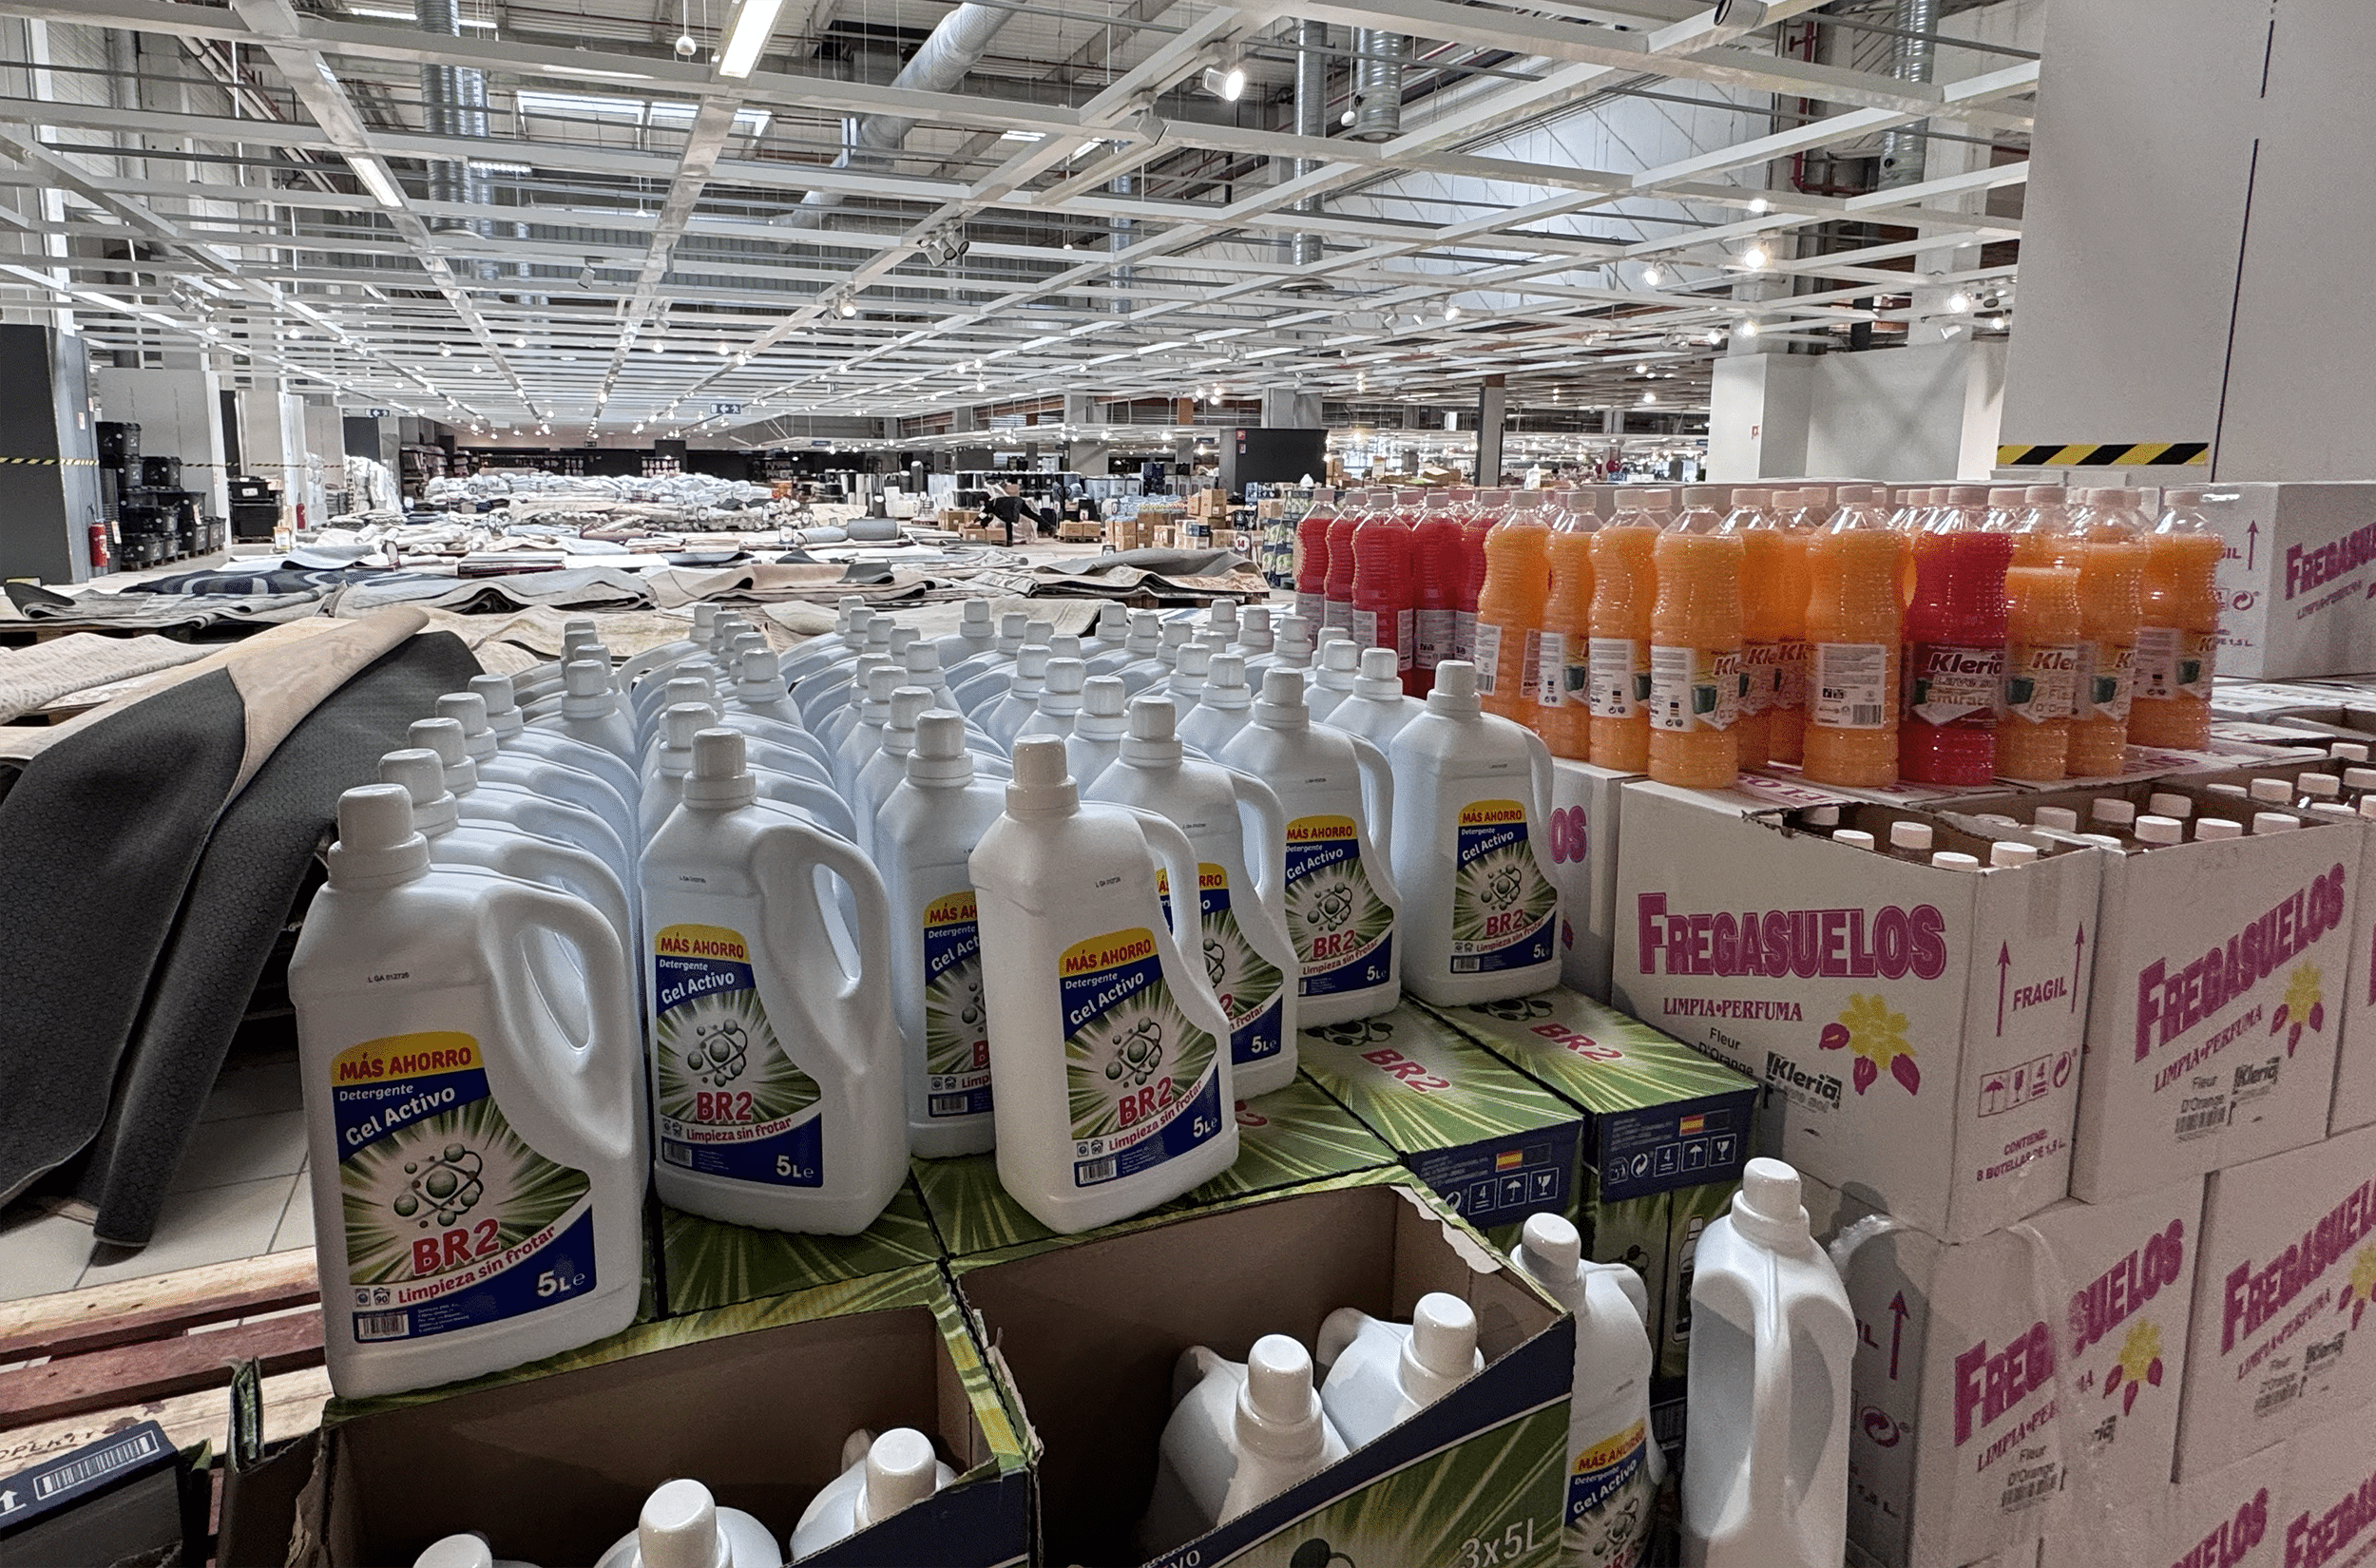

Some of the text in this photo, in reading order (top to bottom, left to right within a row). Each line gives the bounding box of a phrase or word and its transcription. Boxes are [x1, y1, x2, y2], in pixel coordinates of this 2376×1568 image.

[1287, 824, 1352, 840] MÁS AHORRO
[1462, 809, 1522, 824] MÁS AHORRO
[1462, 831, 1514, 861] Gel Activo
[1286, 848, 1344, 880] Gel Activo
[929, 903, 957, 923] MÁS
[1485, 908, 1523, 936] BR2
[661, 932, 744, 959] MÁS AHORRO
[1313, 928, 1355, 959] BR2
[1638, 892, 1946, 980] FREGASUELOS
[660, 959, 708, 971] Detergente
[931, 950, 955, 972] Gel
[1065, 938, 1152, 972] MÁS AHORRO
[1303, 960, 1341, 976] Limpieza
[2135, 862, 2345, 1063] FREGASUELOS
[661, 972, 735, 1004] Gel Activo
[1065, 971, 1118, 990] Detergente
[2012, 976, 2067, 1011] FRAGIL
[1070, 972, 1144, 1025] Gel Activo
[1236, 1004, 1264, 1027] frotar
[1528, 1023, 1624, 1062] BR2
[1710, 1027, 1740, 1050] Fleur
[339, 1046, 472, 1080] MÁS AHORRO
[1360, 1048, 1452, 1094] BR2
[339, 1083, 413, 1101] Detergente
[696, 1092, 753, 1120] BR2
[1118, 1077, 1173, 1126] BR2
[346, 1086, 456, 1146] Gel Activo
[686, 1118, 792, 1144] Limpieza sin frotar
[1108, 1080, 1202, 1151] Limpieza sin frotar
[412, 1218, 500, 1275] BR2
[398, 1226, 555, 1304] Limpieza sin frotar
[2221, 1178, 2376, 1357] FREGASUEL
[1579, 1451, 1606, 1471] MÁS
[1573, 1459, 1638, 1515] Gel Activo
